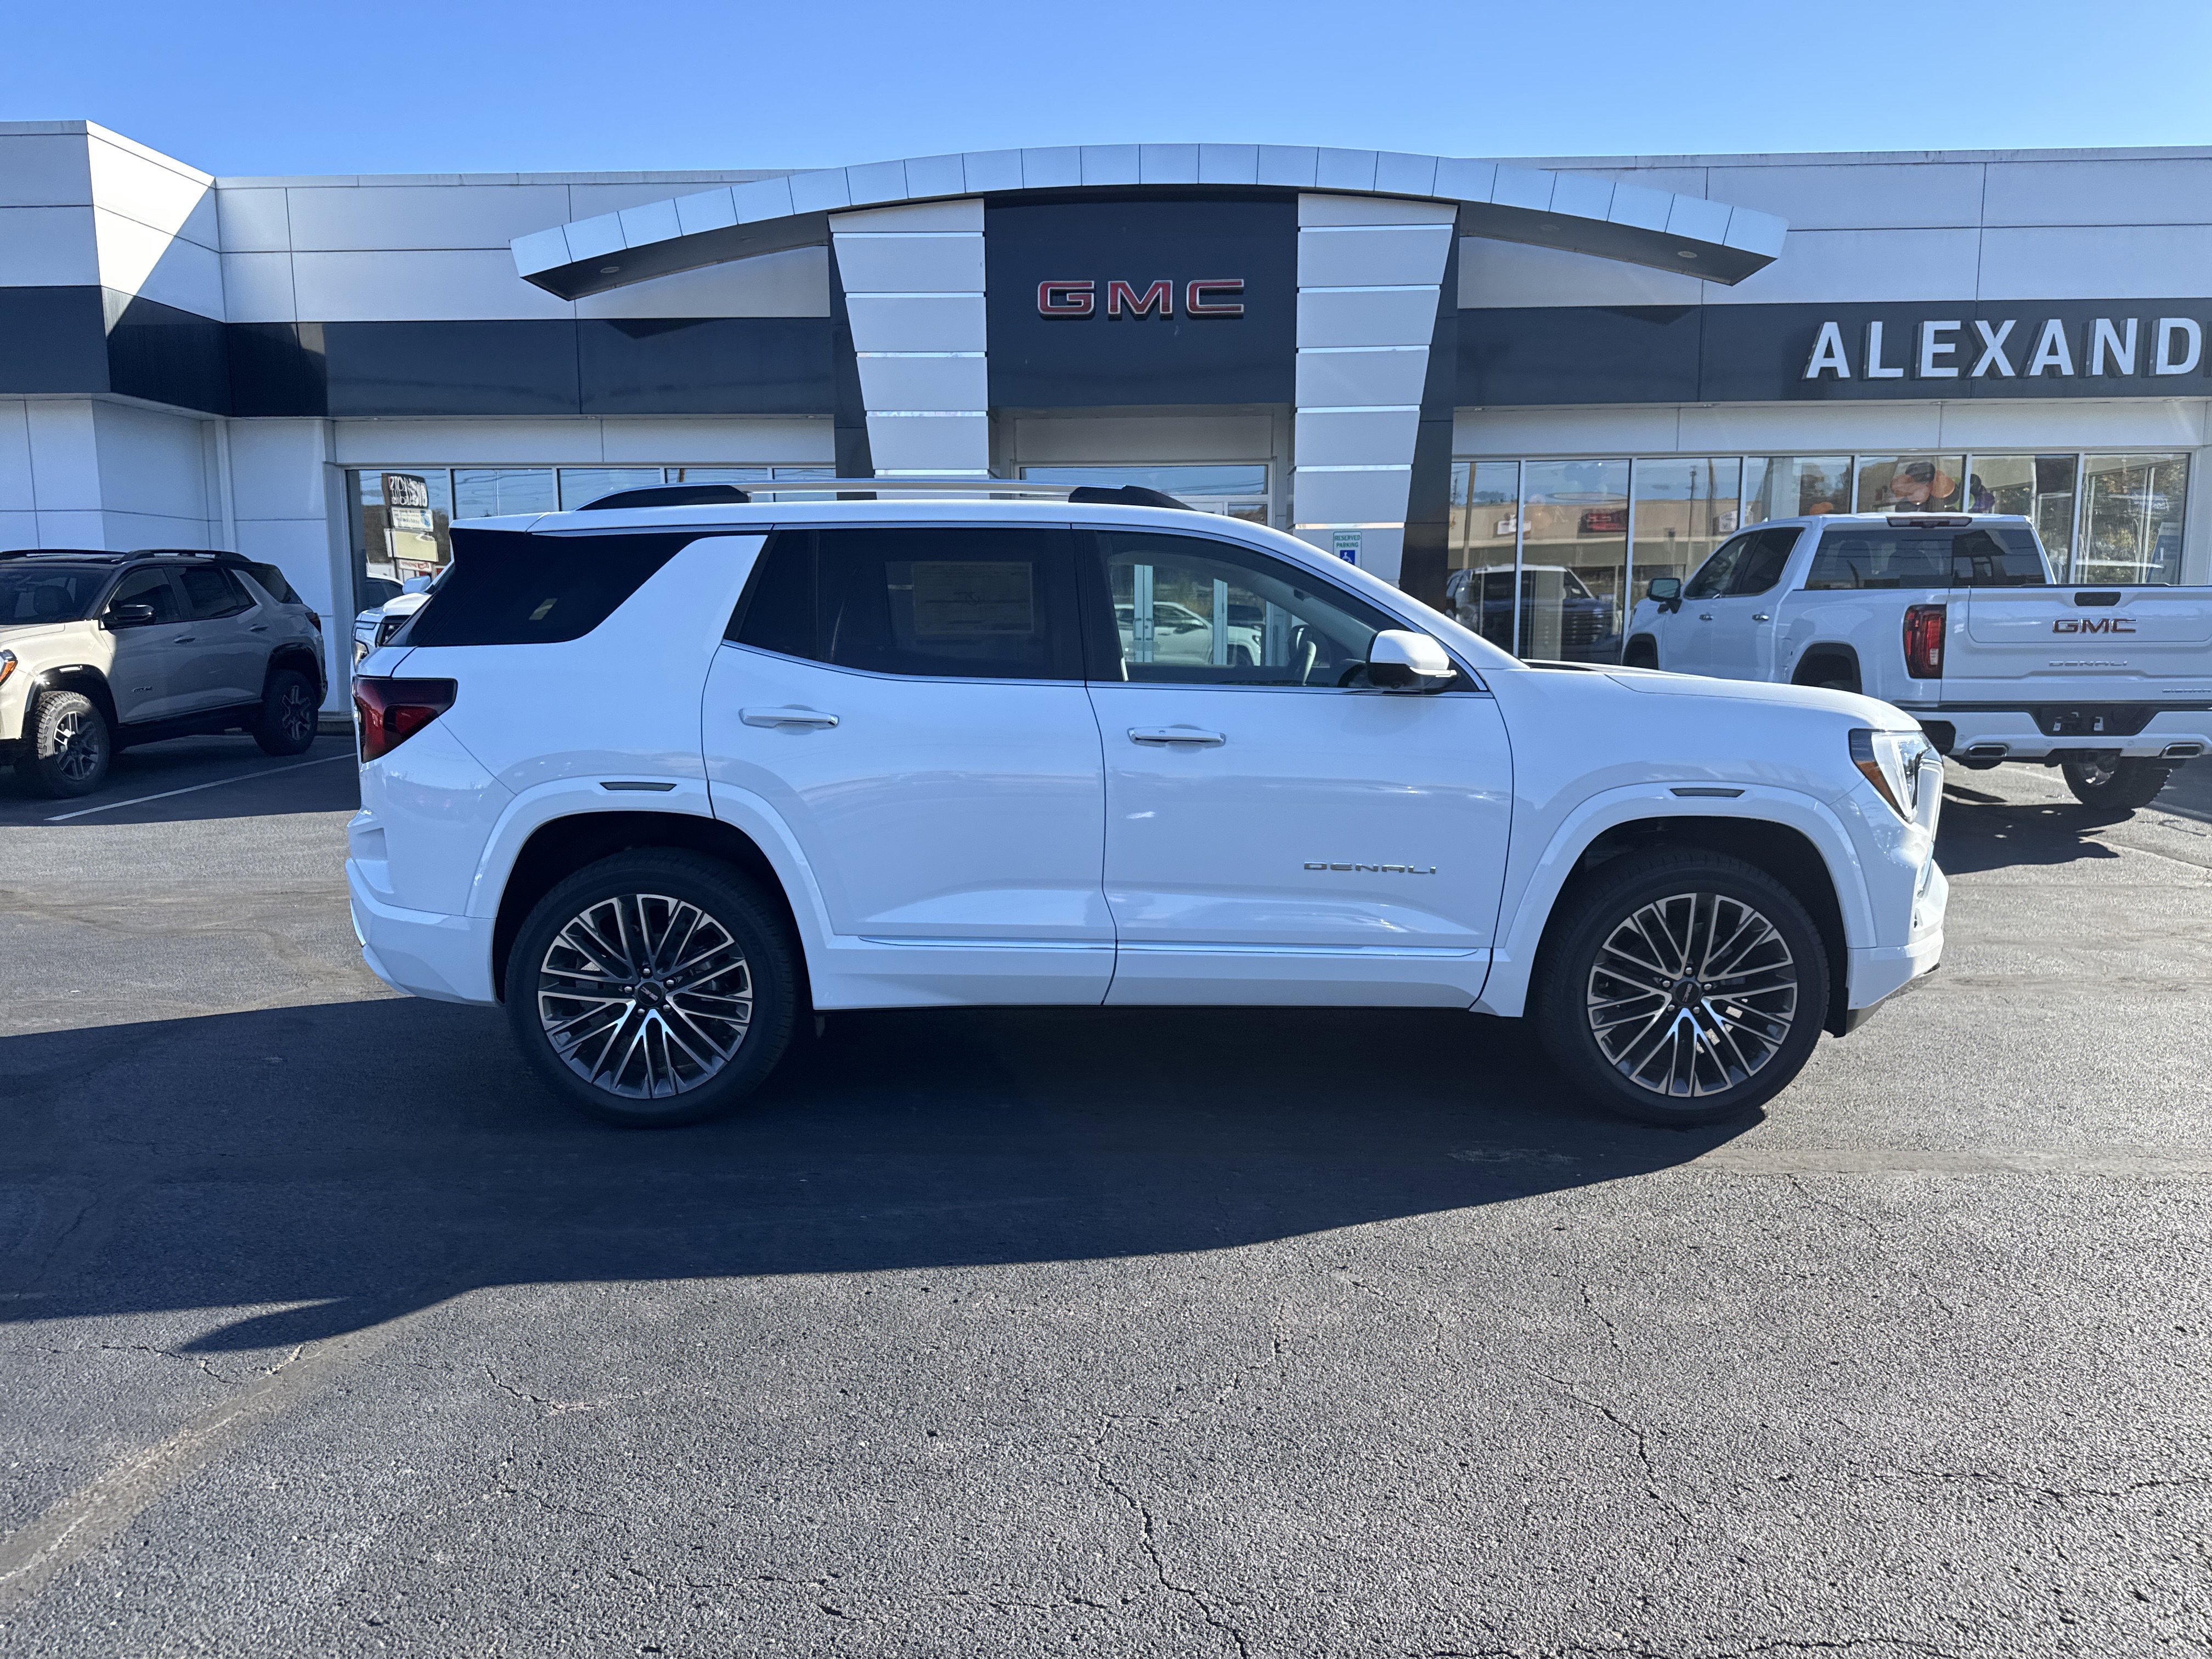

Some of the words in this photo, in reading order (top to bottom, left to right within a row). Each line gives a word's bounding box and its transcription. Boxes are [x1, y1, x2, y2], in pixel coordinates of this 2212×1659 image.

[1037, 279, 1245, 317] GMC
[1807, 317, 2202, 379] ALEXAND
[2052, 618, 2137, 634] GMC
[1304, 861, 1436, 874] DENALI
